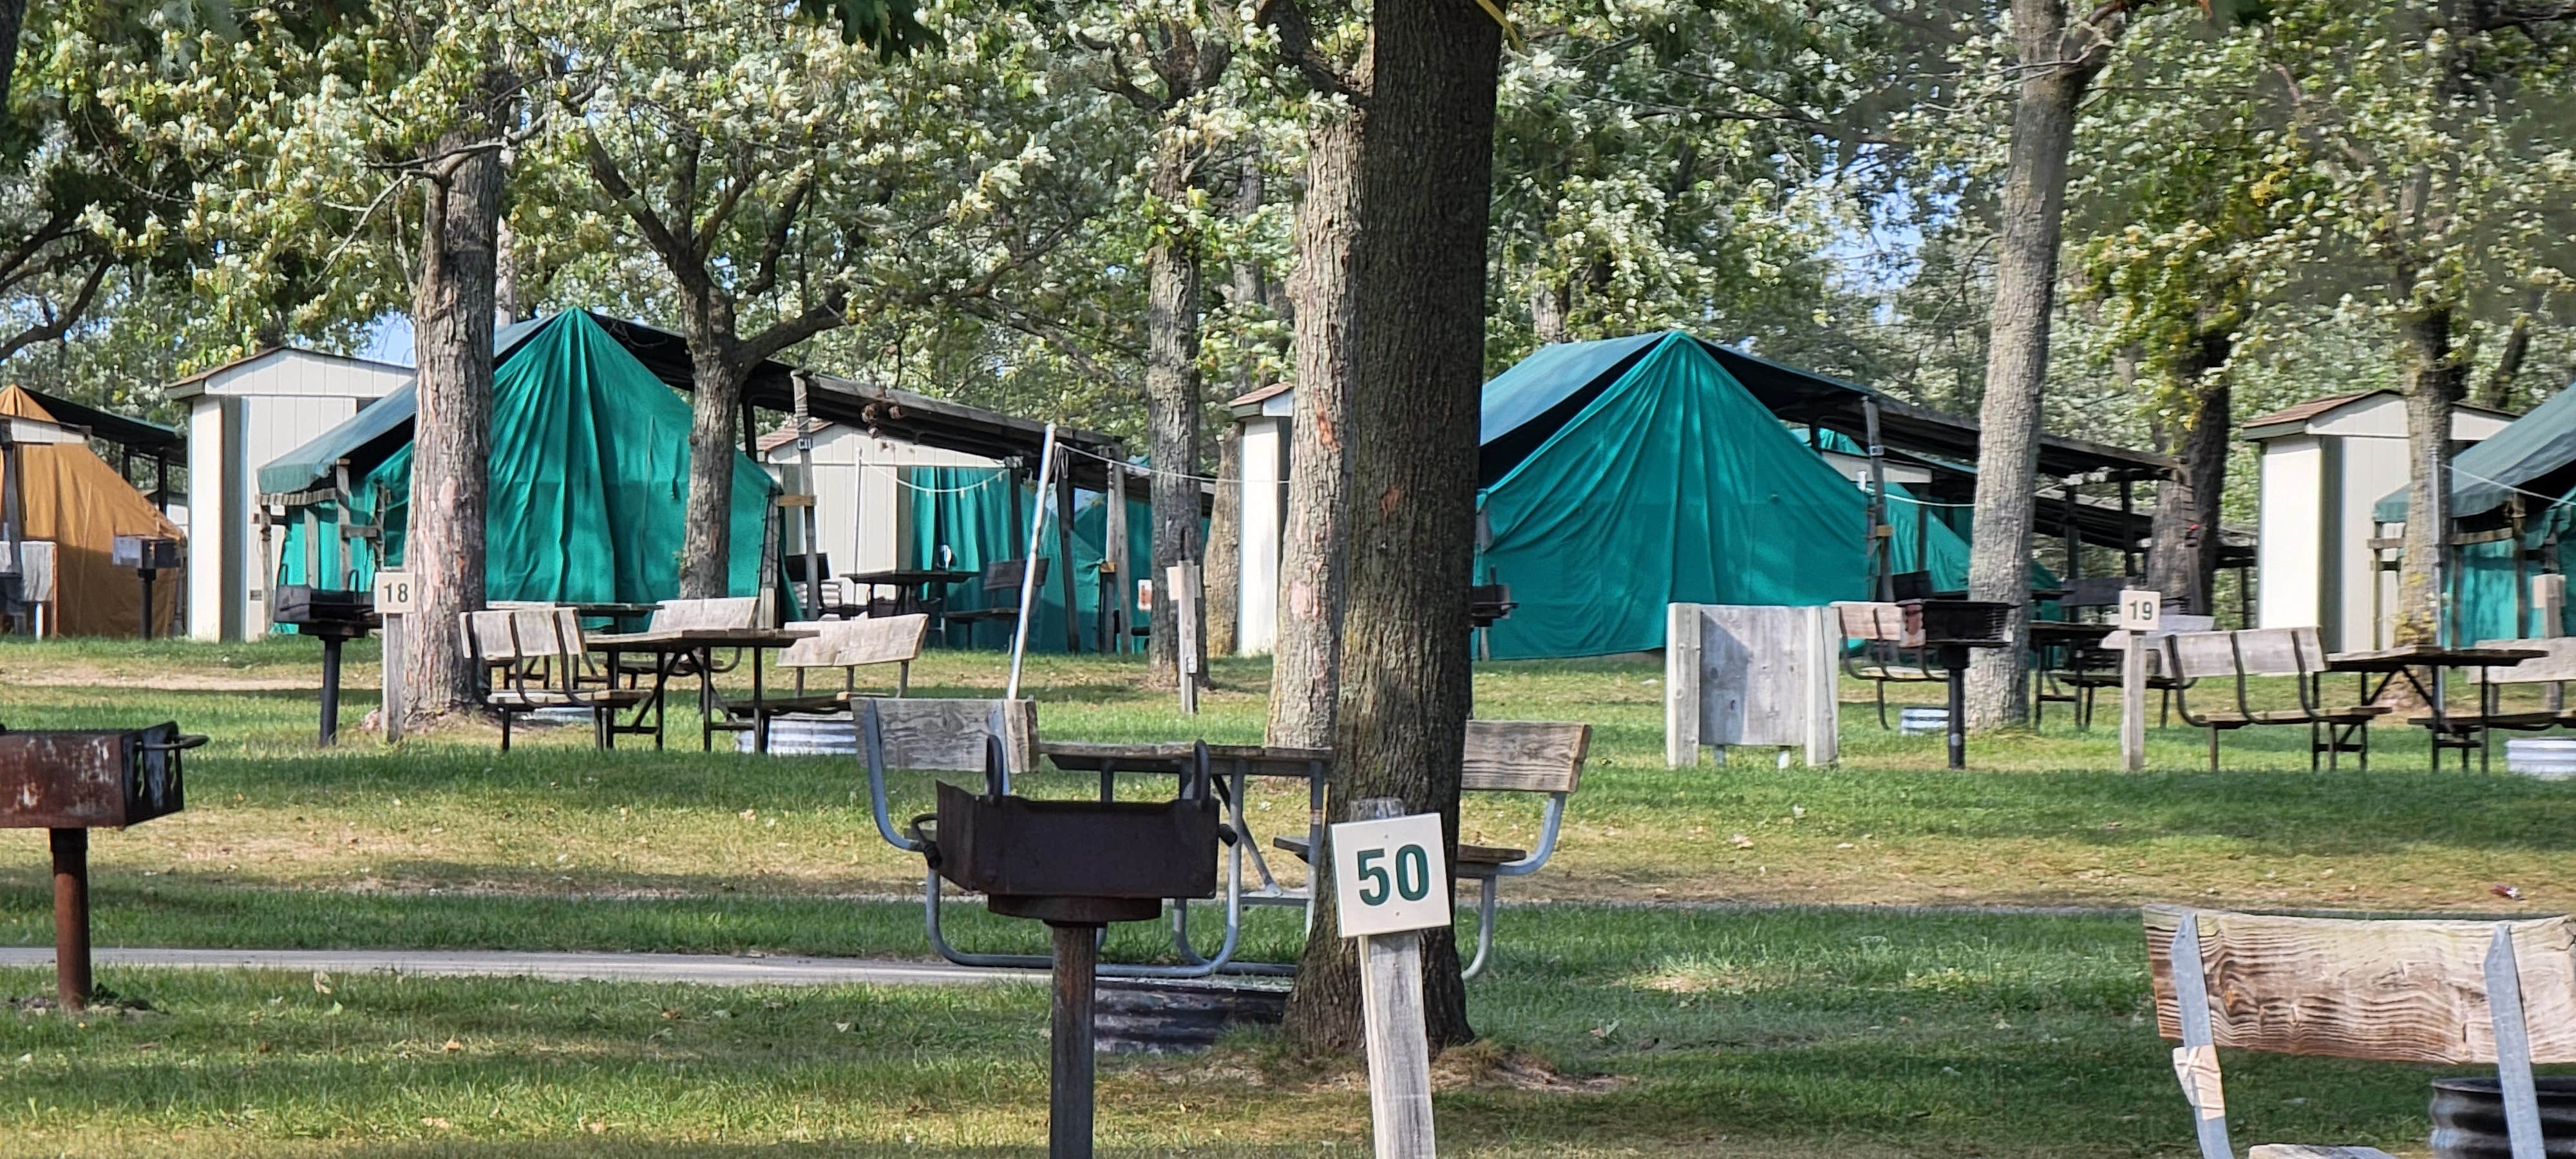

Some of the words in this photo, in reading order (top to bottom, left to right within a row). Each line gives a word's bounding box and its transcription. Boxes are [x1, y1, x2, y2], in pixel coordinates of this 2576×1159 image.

[384, 582, 408, 603] 18
[2129, 600, 2152, 620] 19
[1357, 844, 1430, 906] 50
